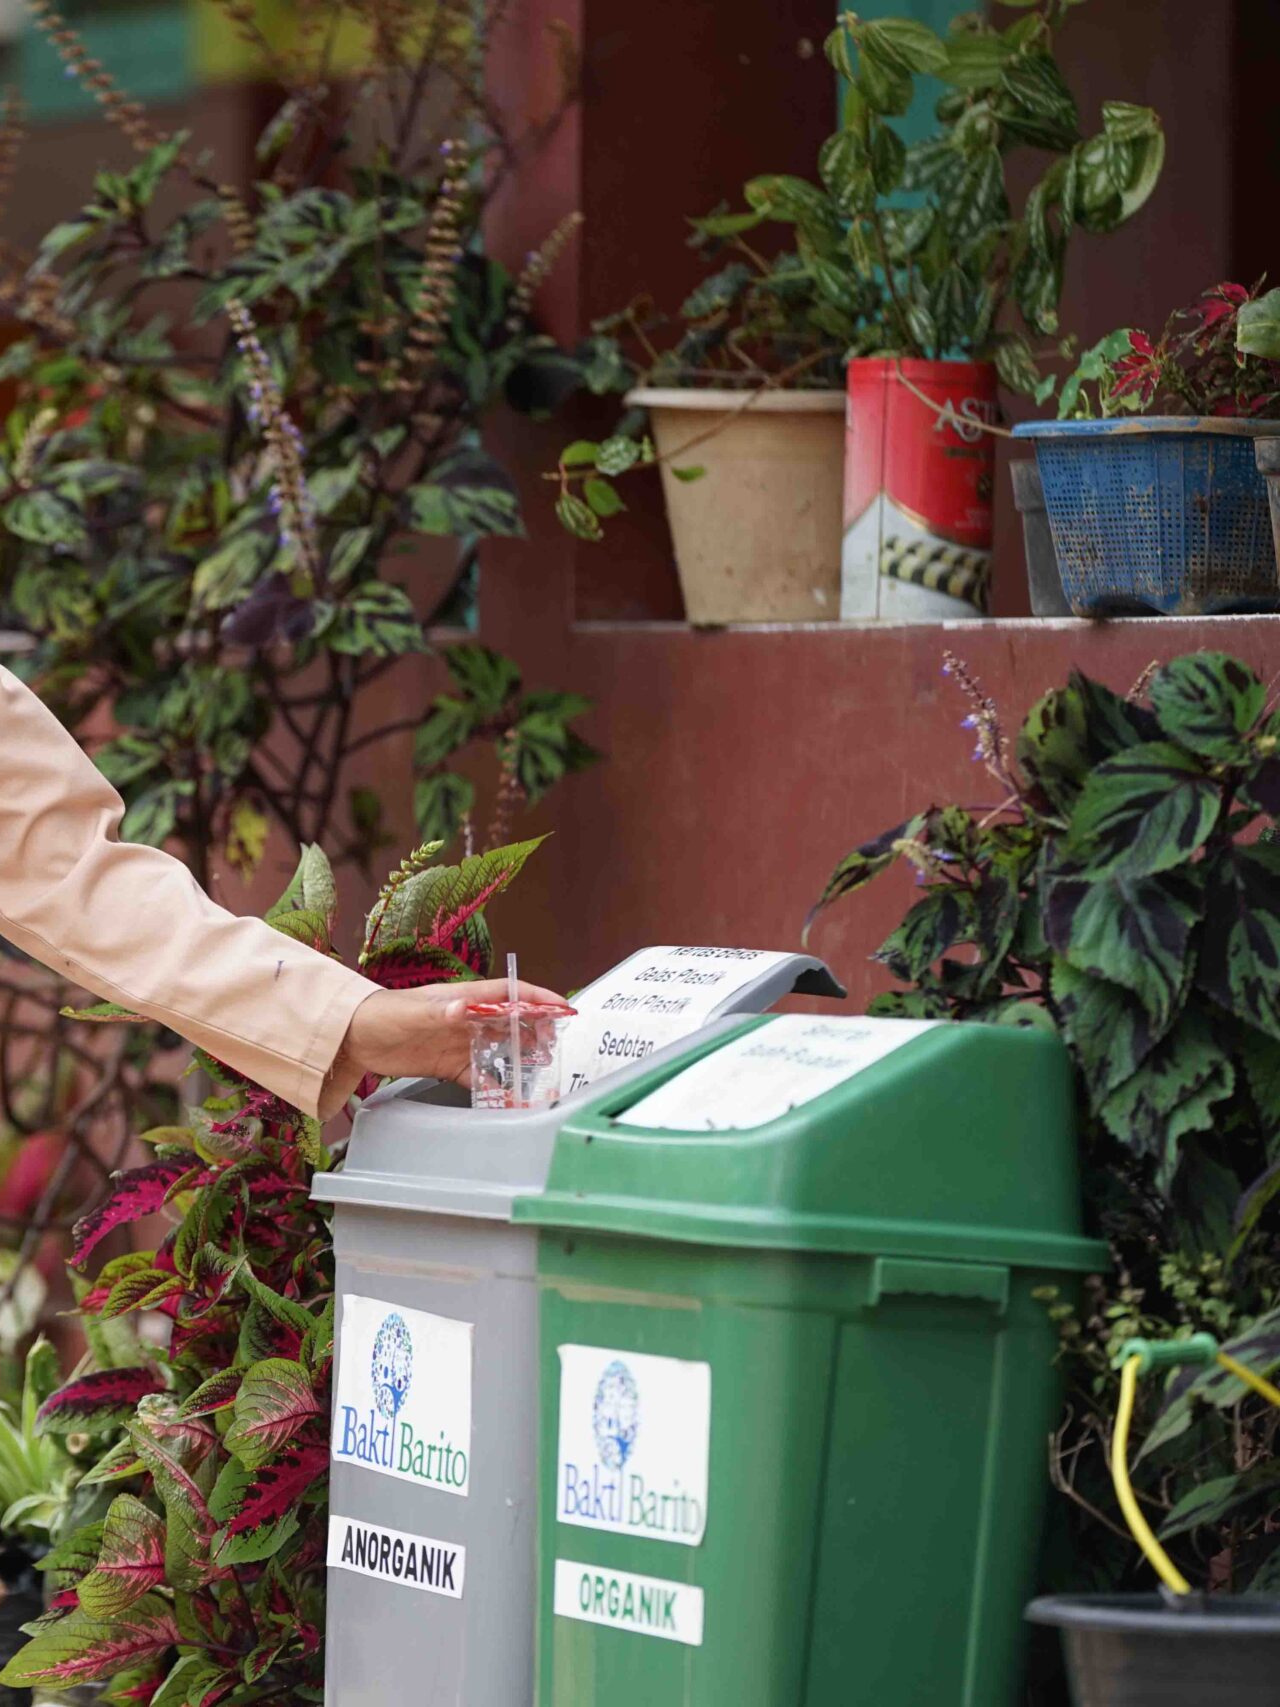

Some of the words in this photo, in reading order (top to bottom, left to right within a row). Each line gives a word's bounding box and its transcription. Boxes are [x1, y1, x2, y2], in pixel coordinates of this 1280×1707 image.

[601, 993, 641, 1011] Botol
[641, 994, 692, 1014] Plastik
[635, 966, 677, 982] Gelas
[672, 968, 727, 985] Plastik
[598, 1030, 654, 1058] Sedotan
[397, 1422, 467, 1487] Barito
[628, 1474, 701, 1535] Barito
[341, 1525, 457, 1591] ANORGANIK
[579, 1573, 678, 1631] ORGANIK
